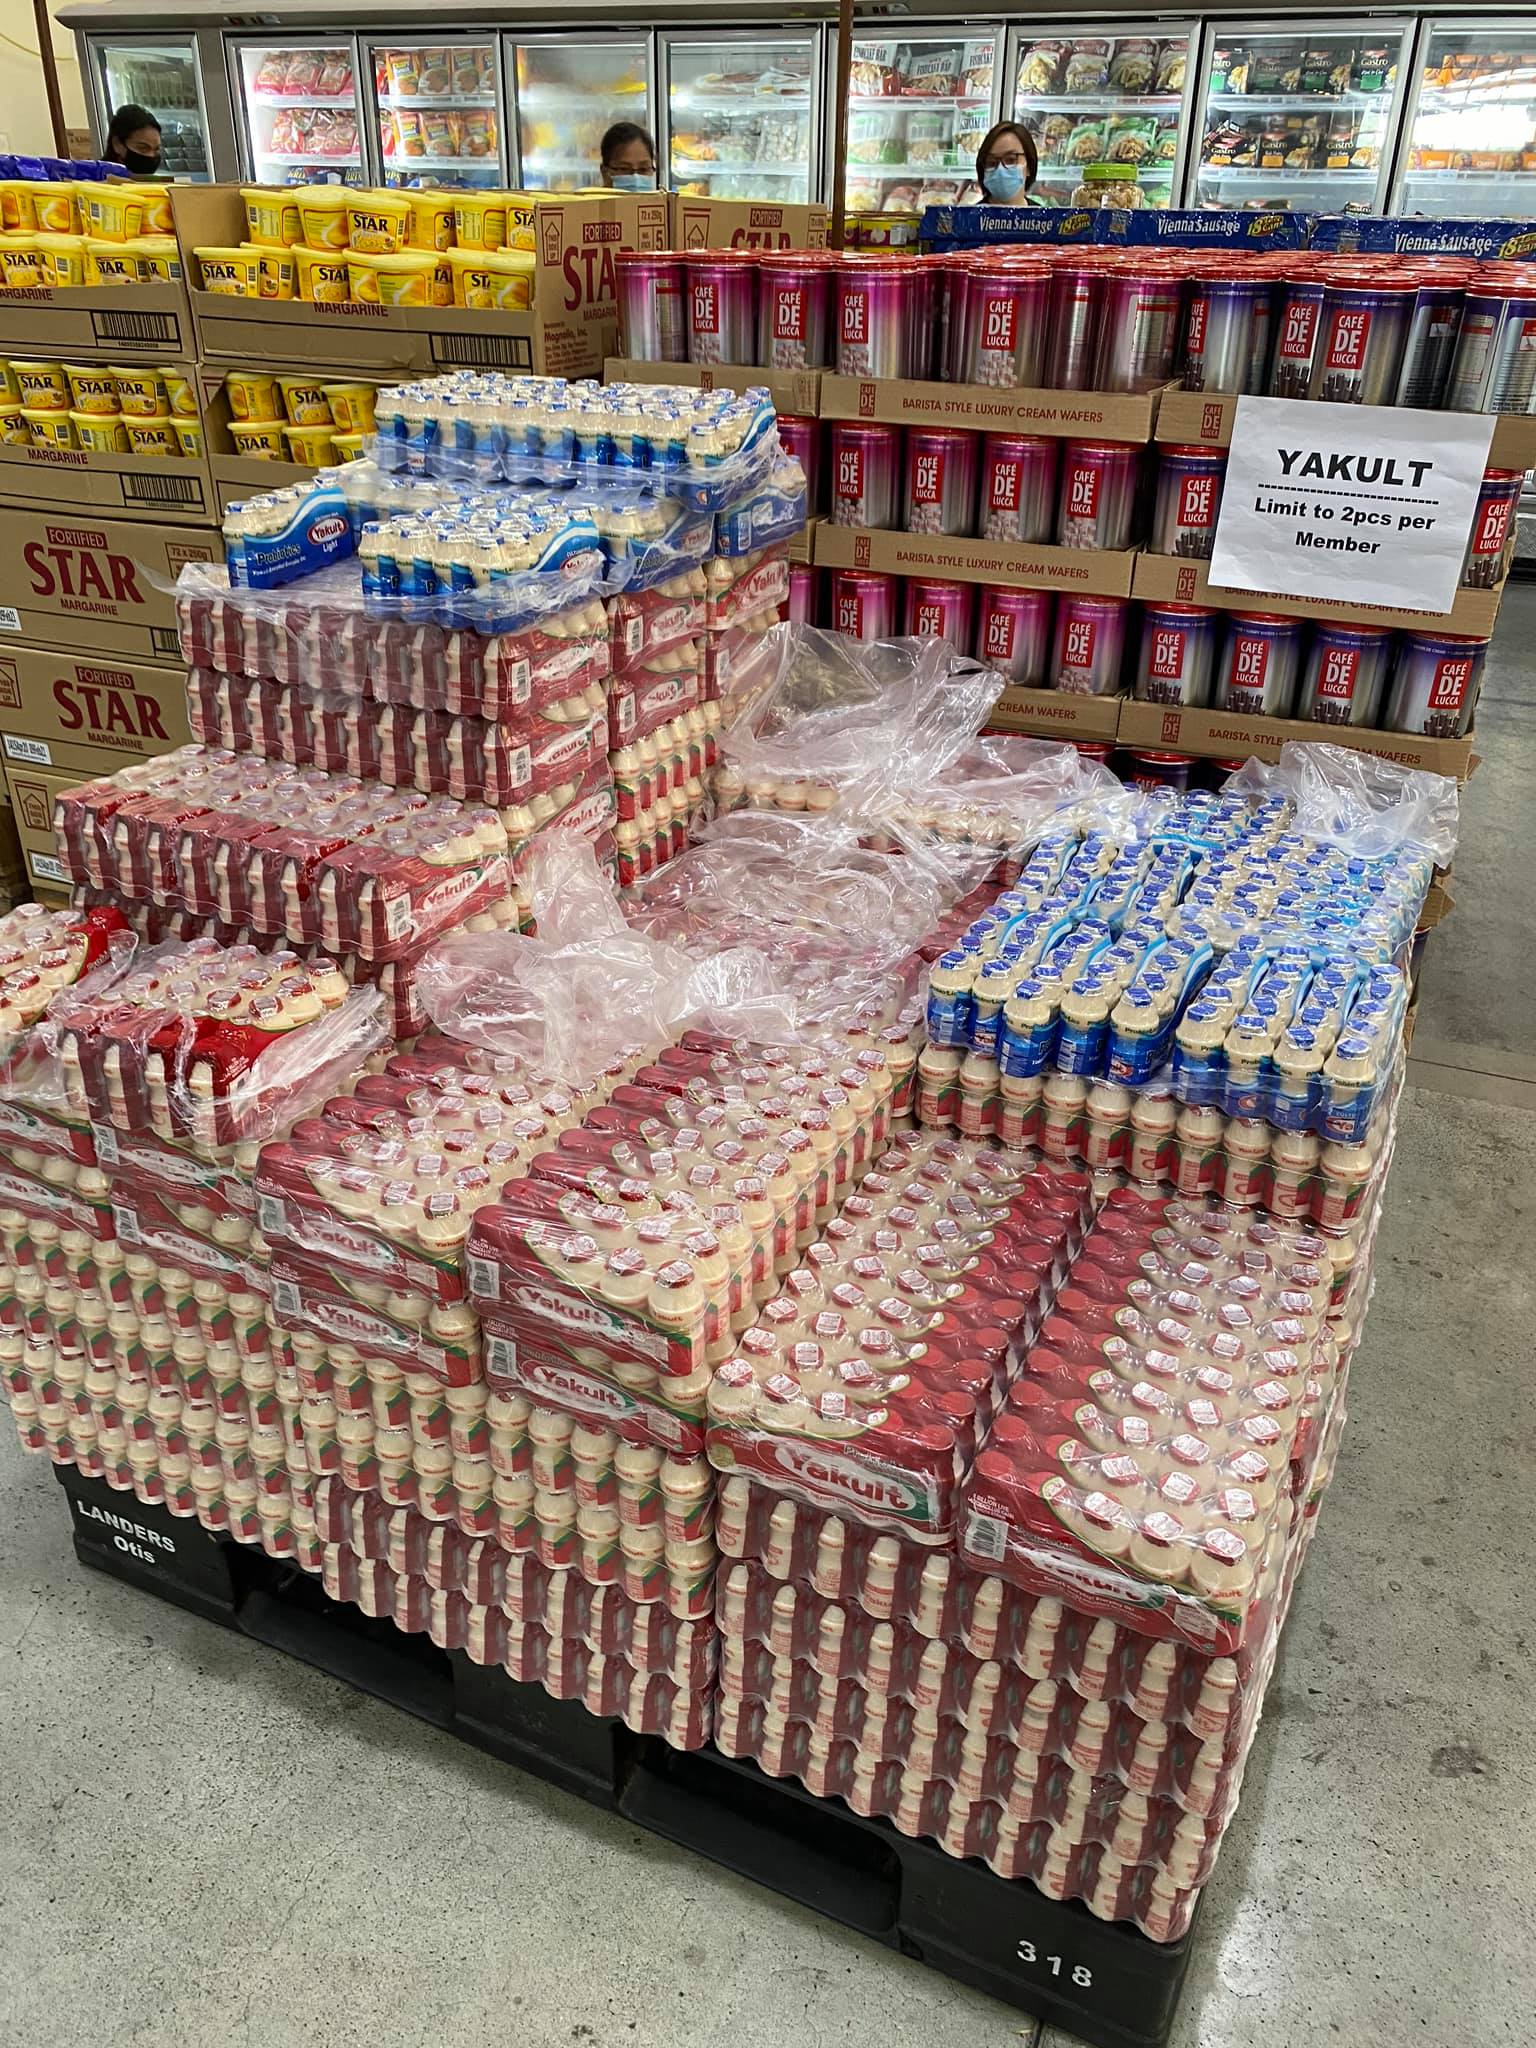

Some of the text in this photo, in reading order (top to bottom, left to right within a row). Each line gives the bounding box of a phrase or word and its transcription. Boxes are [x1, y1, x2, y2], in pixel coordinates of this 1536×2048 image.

[1361, 57, 1388, 66] Gastro
[353, 214, 388, 231] STAR
[514, 211, 535, 226] STA
[979, 216, 1012, 231] Vienna
[1013, 216, 1053, 234] Sausage
[584, 225, 621, 241] FORTIFIED
[1157, 218, 1194, 236] Vienna
[1195, 219, 1240, 237] Sausage
[1395, 233, 1437, 253] Vienna
[1438, 233, 1492, 257] Sausage
[4, 253, 37, 266] STAR
[203, 264, 236, 279] STAR
[0, 288, 53, 300] ARGARINE
[695, 285, 713, 298] CAFÉ
[779, 290, 800, 305] CAFÉ
[844, 293, 863, 307] CAFÉ
[989, 299, 1012, 313] CAFÉ
[314, 302, 389, 317] MARGARINE
[584, 307, 616, 321] MARGARIN
[696, 300, 713, 319] DE
[779, 304, 800, 325] DE
[1289, 306, 1312, 320] CAFÉ
[695, 320, 713, 330] LUCCA
[845, 308, 863, 329] DE
[988, 315, 1010, 336] DE
[1338, 313, 1364, 329] CAFÉ
[778, 325, 799, 337] LUCCA
[844, 329, 863, 339] LUCCA
[1286, 320, 1308, 343] DE
[987, 336, 1010, 347] LUCCA
[1284, 342, 1305, 354] LUCCA
[1335, 329, 1360, 353] DE
[1331, 353, 1356, 365] LUCCA
[21, 376, 54, 388] STAR
[79, 380, 113, 393] STAR
[861, 394, 874, 406] DE
[902, 398, 1103, 423] BARISTA STYLE LUXURY CREAM WAFERS
[5, 417, 28, 430] STA
[1203, 416, 1219, 429] DE
[133, 431, 167, 443] STAR
[238, 436, 271, 449] STAR
[27, 449, 89, 464] MARGARINE
[839, 451, 858, 464] CAFÉ
[918, 455, 938, 469] CAFÉ
[839, 465, 858, 484] DE
[995, 462, 1017, 476] CAFÉ
[1074, 469, 1096, 483] CAFÉ
[1277, 449, 1433, 488] YAKULT
[917, 469, 936, 490] DE
[994, 476, 1015, 497] DE
[1187, 477, 1212, 491] CAFÉ
[839, 484, 858, 494] LUCCA
[916, 489, 936, 500] LUCCA
[1072, 483, 1093, 505] DE
[992, 496, 1014, 507] LUCCA
[1070, 503, 1091, 515] LUCCA
[1185, 492, 1209, 513] DE
[1254, 497, 1436, 531] Limit to 2pcs per
[1487, 502, 1509, 517] CAFÉ
[1183, 513, 1207, 523] LUCCA
[314, 522, 343, 539] Yakult
[1483, 518, 1505, 538] DE
[49, 529, 105, 547] FORTIFIED
[1295, 531, 1381, 555] Member
[1479, 539, 1501, 550] LUCCA
[322, 540, 338, 552] Light
[856, 546, 869, 557] DE
[23, 541, 146, 604] STAR
[896, 552, 1089, 579] BARISTA STYLE LUXURY CREAM WAFERS
[1178, 579, 1193, 591] DE
[60, 598, 118, 616] MARGARINE
[840, 597, 857, 610] CAFÉ
[919, 605, 940, 618] CAFÉ
[840, 610, 857, 629] DE
[990, 613, 1010, 627] CAFÉ
[919, 619, 938, 636] DE
[1069, 621, 1091, 635] CAFÉ
[989, 627, 1008, 646] DE
[1157, 632, 1179, 647] CAFÉ
[987, 645, 1006, 655] LUCCA
[1067, 635, 1088, 655] DE
[1240, 640, 1264, 655] CAFÉ
[1065, 653, 1087, 664] LUCCA
[1155, 645, 1177, 664] DE
[1329, 651, 1353, 665] CAFÉ
[1154, 663, 1176, 675] LUCCA
[1238, 653, 1260, 673] DE
[1442, 662, 1466, 676] CAFÉ
[78, 669, 132, 688] FORTIFIED
[1235, 672, 1259, 684] LUCCA
[1325, 663, 1349, 685] DE
[1323, 682, 1348, 695] LUCCA
[1437, 675, 1462, 696] DE
[1435, 695, 1459, 705] LUCCA
[53, 680, 170, 740] STAR
[998, 703, 1076, 720] CREAM WAFERS
[1163, 723, 1179, 734] DE
[87, 732, 144, 750] MARGARINE
[1208, 729, 1283, 746] BARISTA STYLE
[1375, 750, 1422, 764] WAFERS
[427, 874, 475, 904] Yakult
[525, 1287, 607, 1326] Yakult
[323, 1305, 389, 1335] Yakult
[540, 1366, 623, 1404] Yakult
[787, 1447, 910, 1510] Yakult
[77, 1500, 176, 1553] LANDERS
[113, 1535, 156, 1564] Otis
